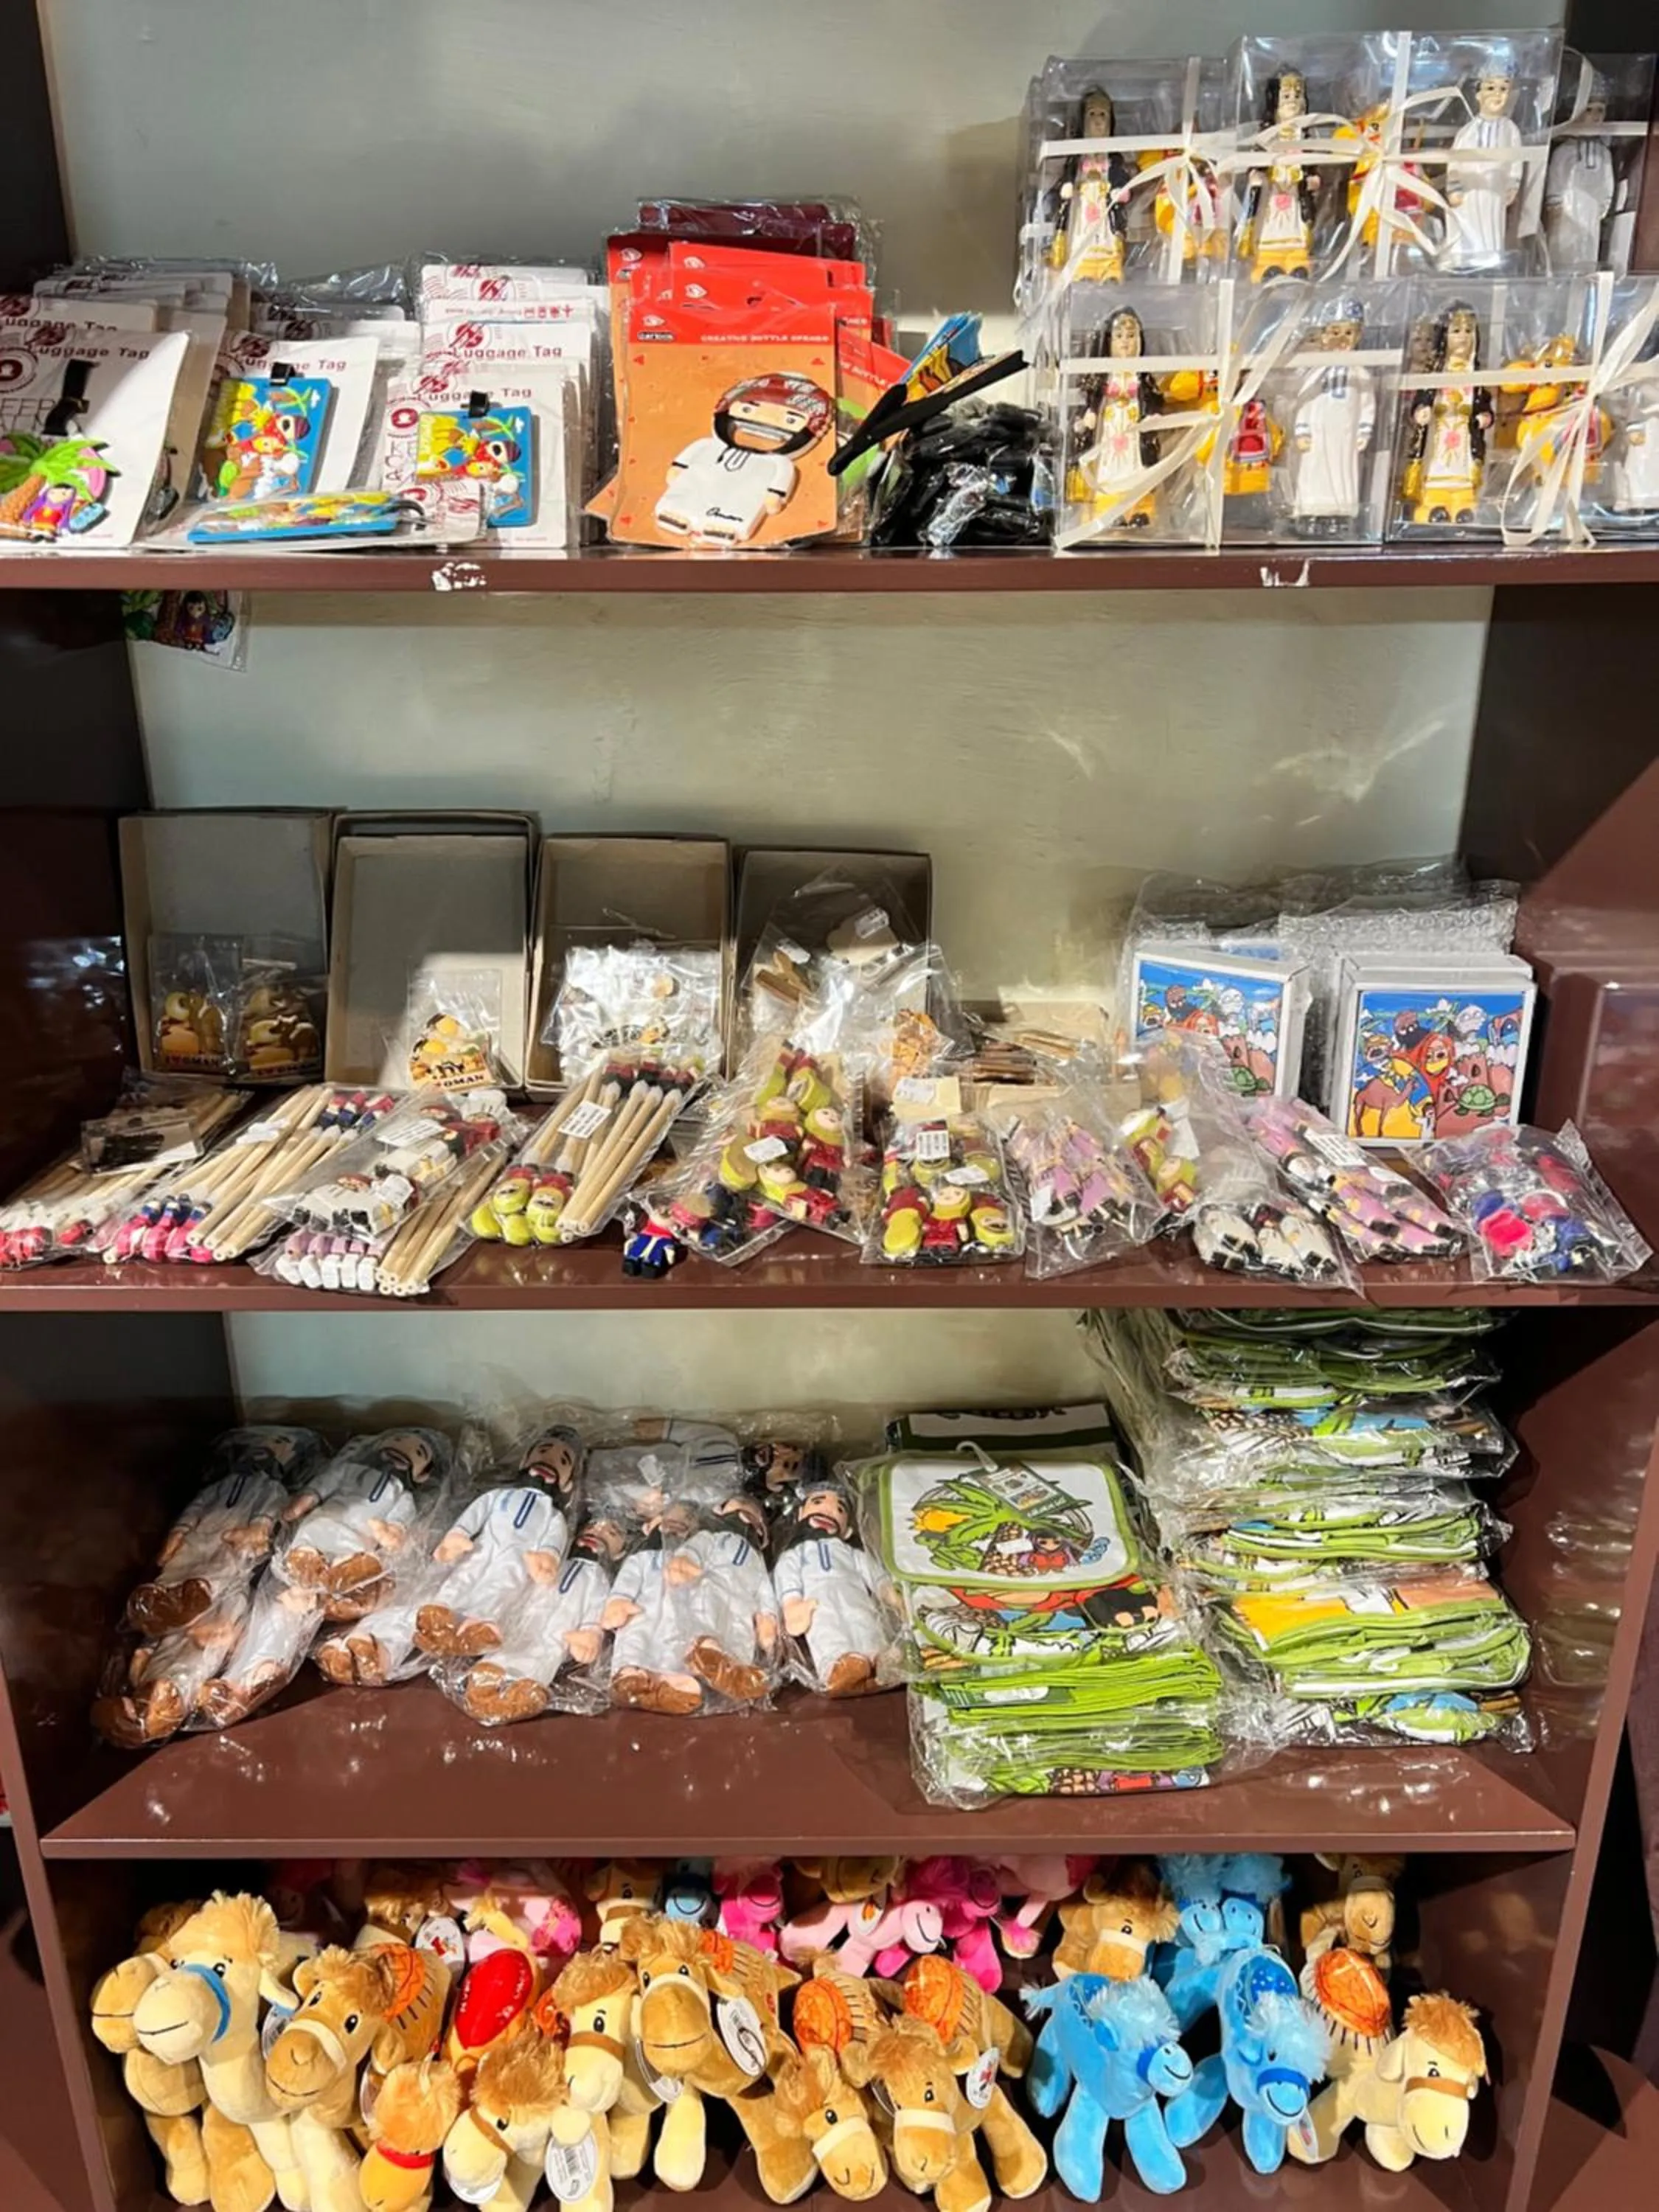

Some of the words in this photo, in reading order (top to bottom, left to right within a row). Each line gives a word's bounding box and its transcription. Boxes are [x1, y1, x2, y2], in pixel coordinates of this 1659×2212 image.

[119, 347, 150, 361] Tag
[532, 345, 563, 358] Tag
[318, 358, 347, 372] Tag
[499, 387, 532, 399] Tag
[443, 1075, 484, 1087] OMAN
